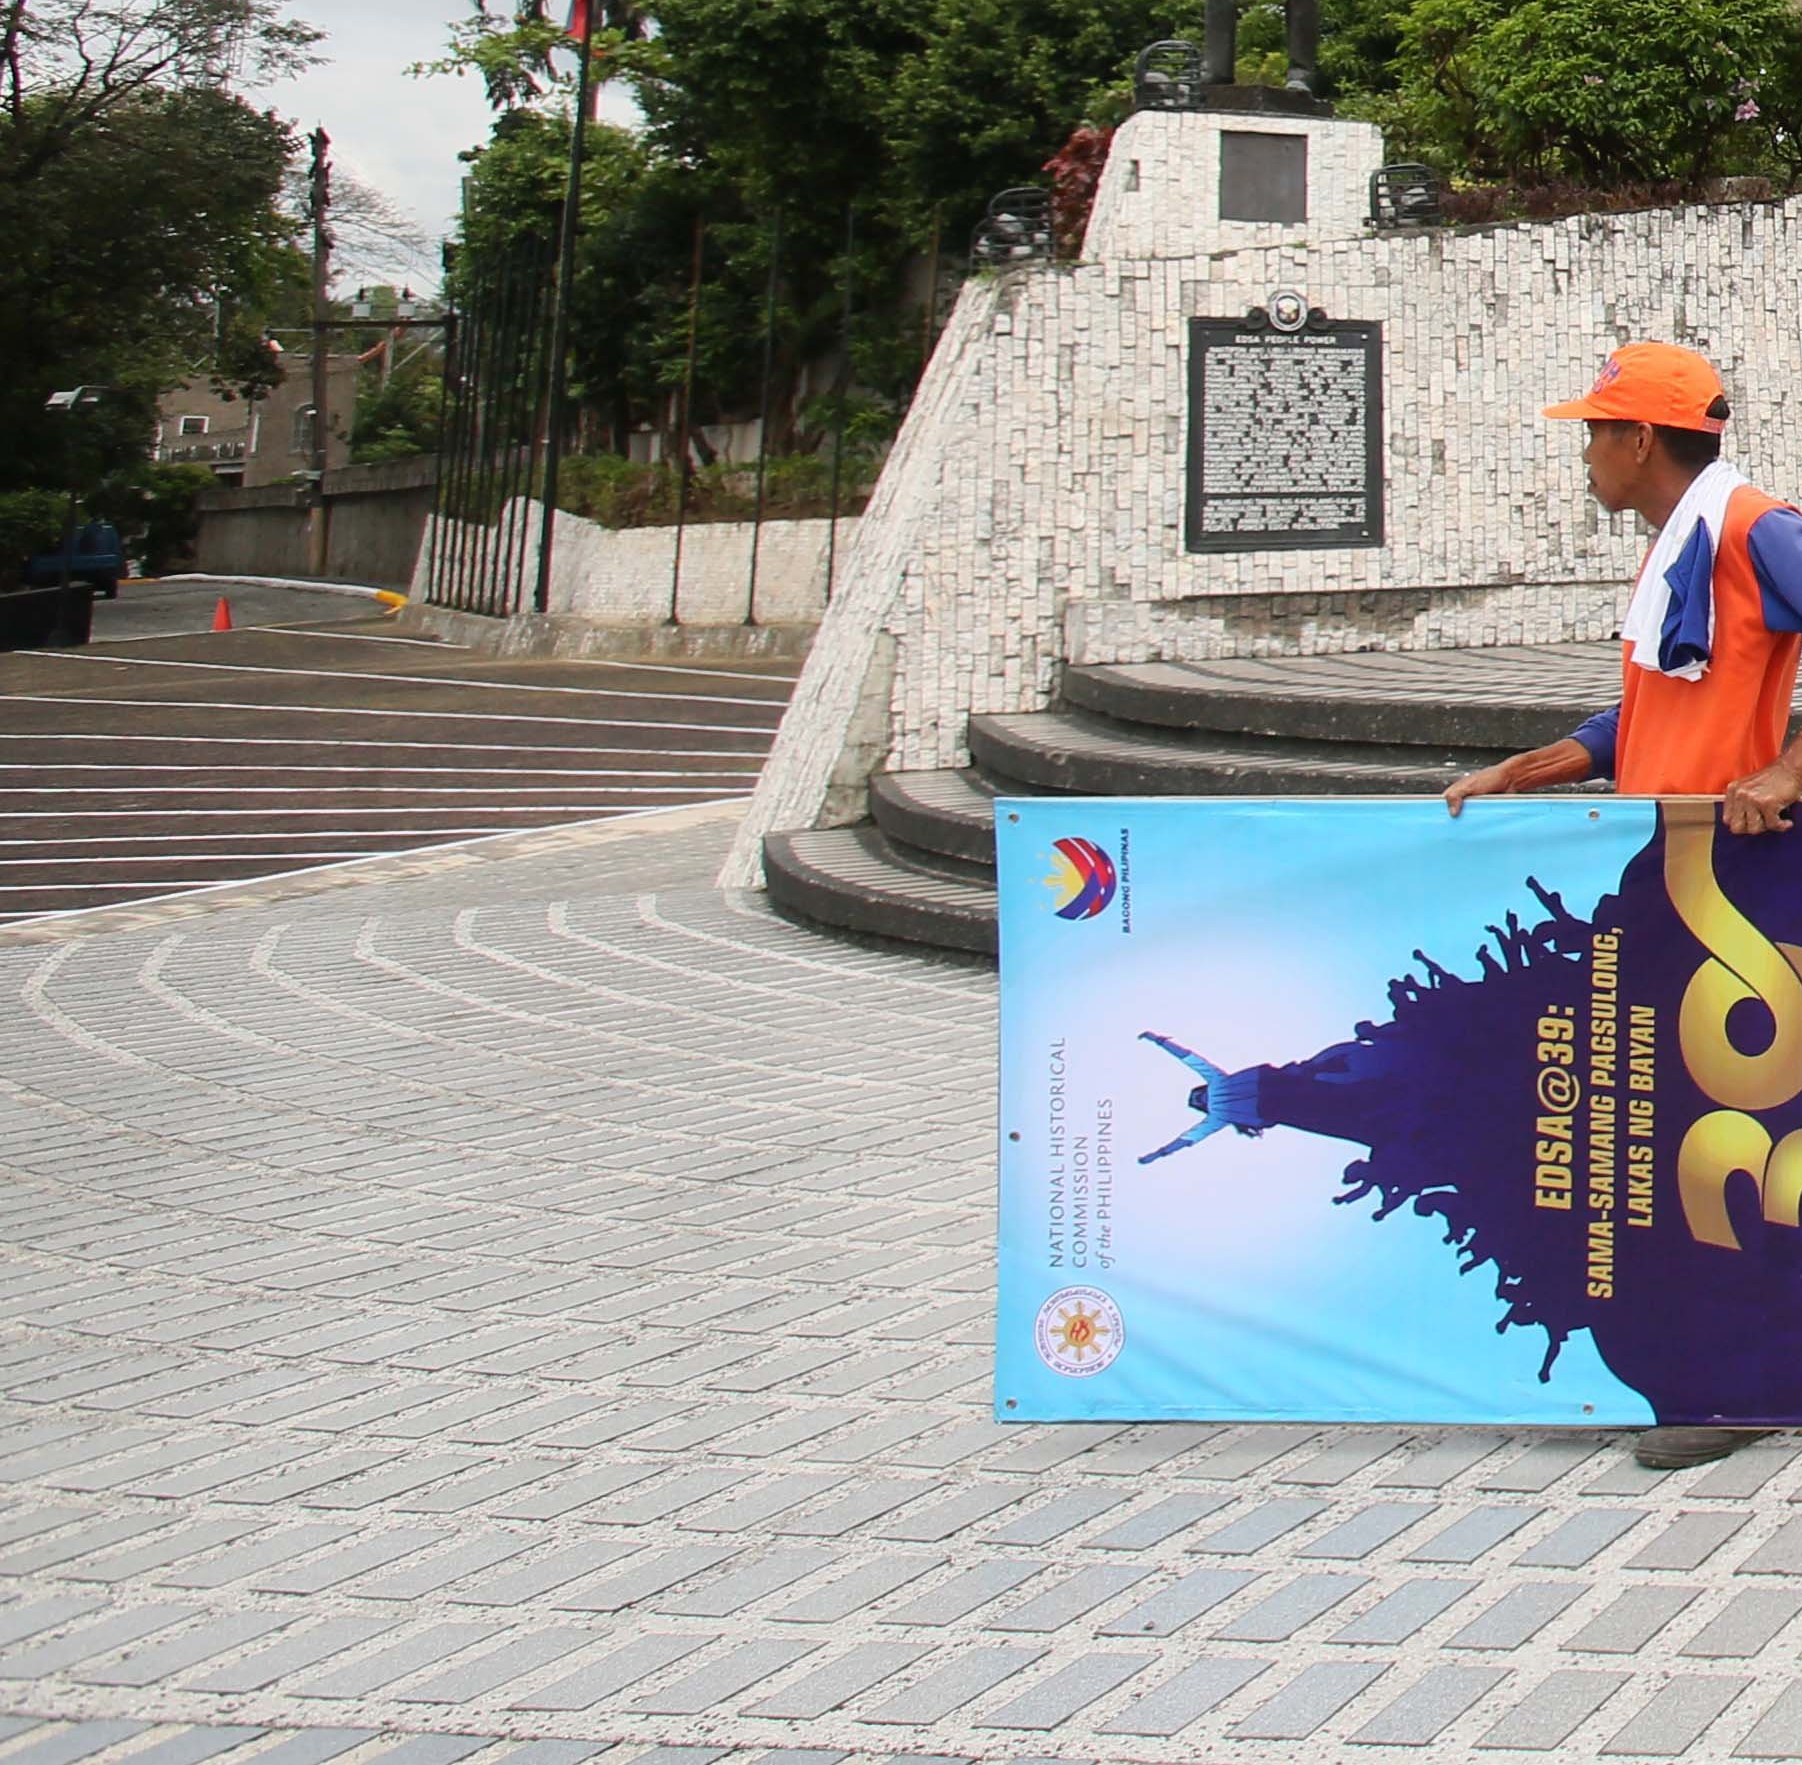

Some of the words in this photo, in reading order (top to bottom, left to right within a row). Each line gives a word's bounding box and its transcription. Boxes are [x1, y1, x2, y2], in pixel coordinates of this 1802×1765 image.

[1120, 827, 1129, 883] PILIPINAS
[1591, 927, 1623, 1087] PAGSULONG,
[1630, 1005, 1656, 1092] BAYAN
[1049, 1037, 1066, 1156] HISTORICAL
[1535, 1004, 1580, 1210] EDSA@39:
[1630, 1099, 1655, 1137] NG
[1072, 1136, 1089, 1268] COMMISSION
[1097, 1098, 1112, 1220] PHILIPPINES
[1587, 1095, 1615, 1298] SAMA-SAMANG
[1628, 1145, 1654, 1227] LAKAS
[1049, 1164, 1065, 1268] NATIONAL
[1095, 1251, 1115, 1269] of
[1097, 1225, 1111, 1249] the
